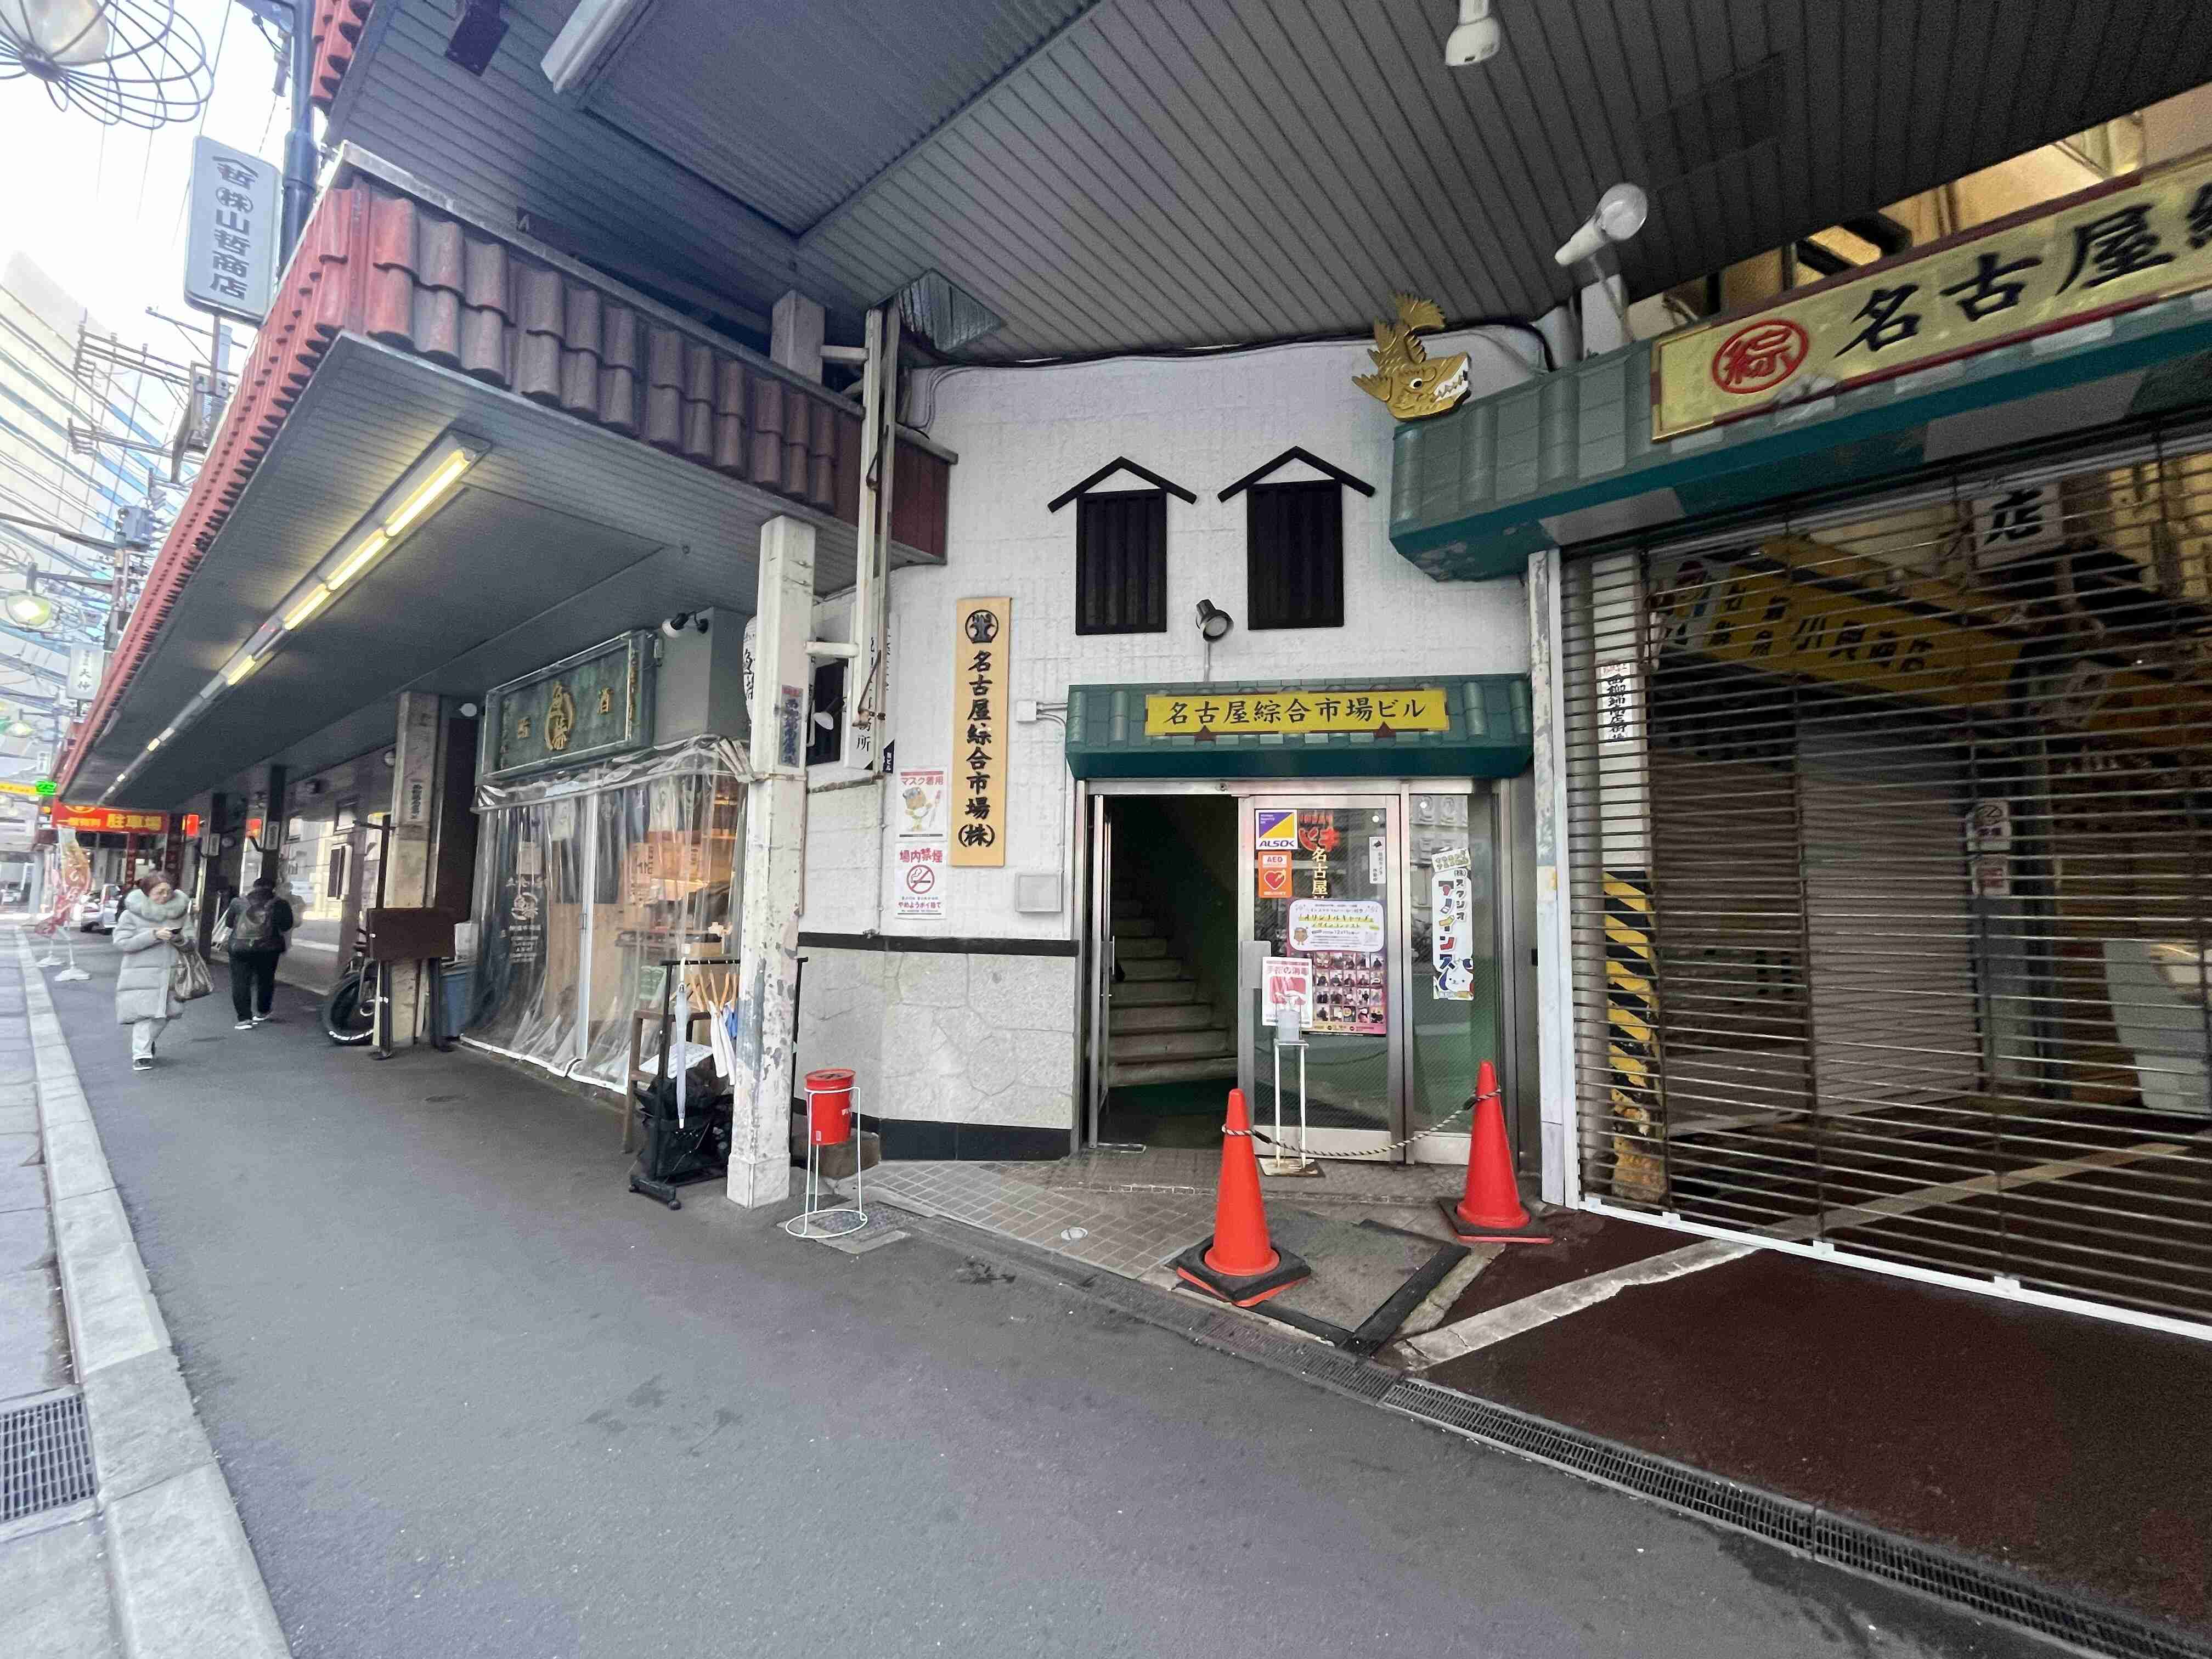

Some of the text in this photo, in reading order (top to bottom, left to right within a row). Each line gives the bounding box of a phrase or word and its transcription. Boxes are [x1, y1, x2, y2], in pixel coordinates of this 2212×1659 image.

[1164, 697, 1426, 724] 名古屋綜合市場ビル
[900, 776, 944, 786] マスク着用
[900, 848, 943, 862] 場内禁煙
[1312, 847, 1328, 900] 名古屋
